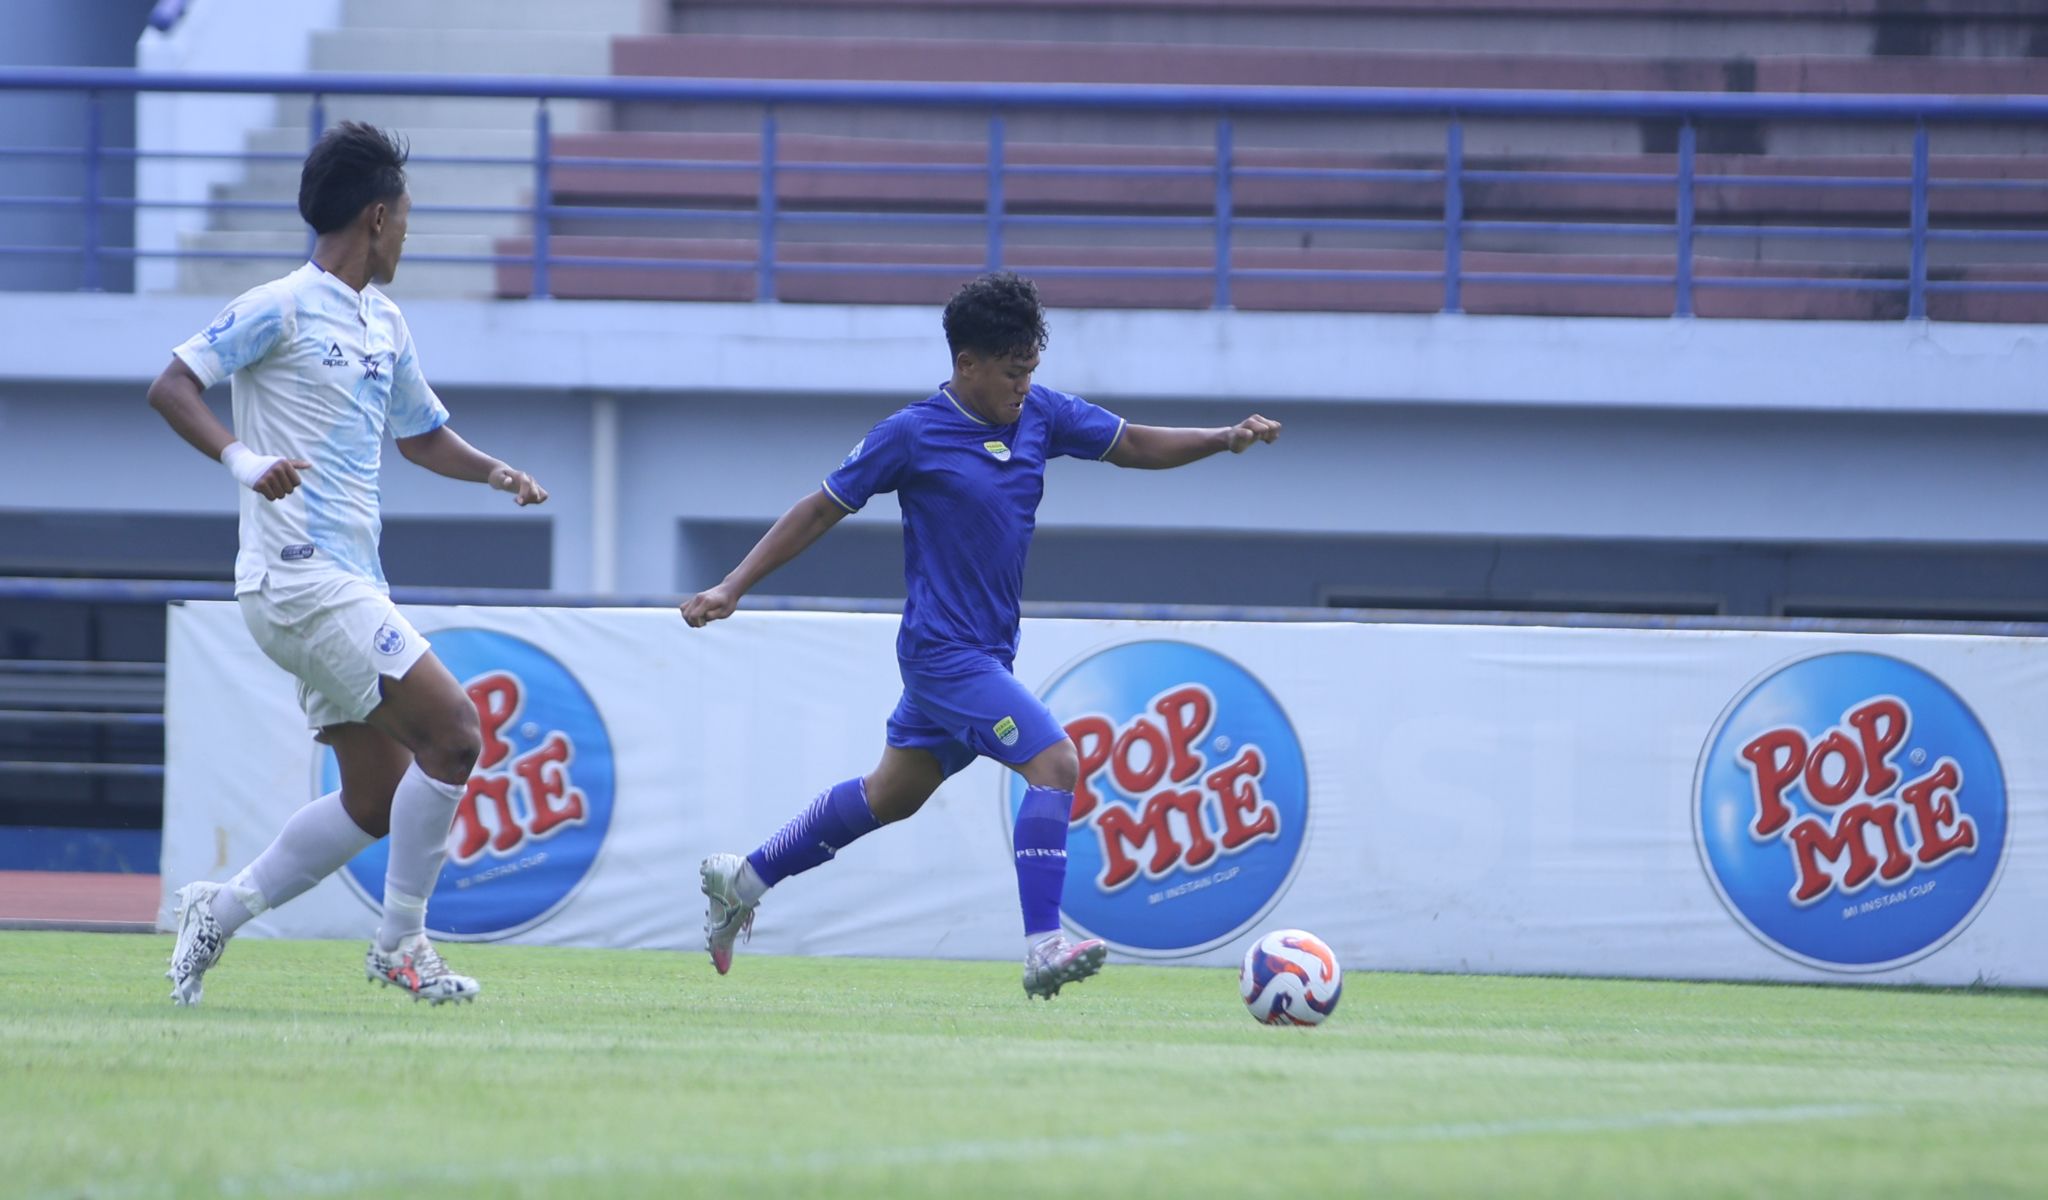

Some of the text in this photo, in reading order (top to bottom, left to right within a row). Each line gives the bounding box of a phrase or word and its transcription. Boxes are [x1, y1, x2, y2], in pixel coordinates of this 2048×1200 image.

[322, 358, 349, 368] apex
[1064, 687, 1212, 822] POP
[1742, 698, 1907, 836] POP
[520, 852, 548, 868] CUP
[1097, 749, 1277, 888] MIE
[1789, 762, 1975, 901] MIE
[1166, 876, 1212, 899] INSTAN
[1213, 866, 1240, 883] CUP
[1843, 880, 1937, 919] MI INSTAN CUP
